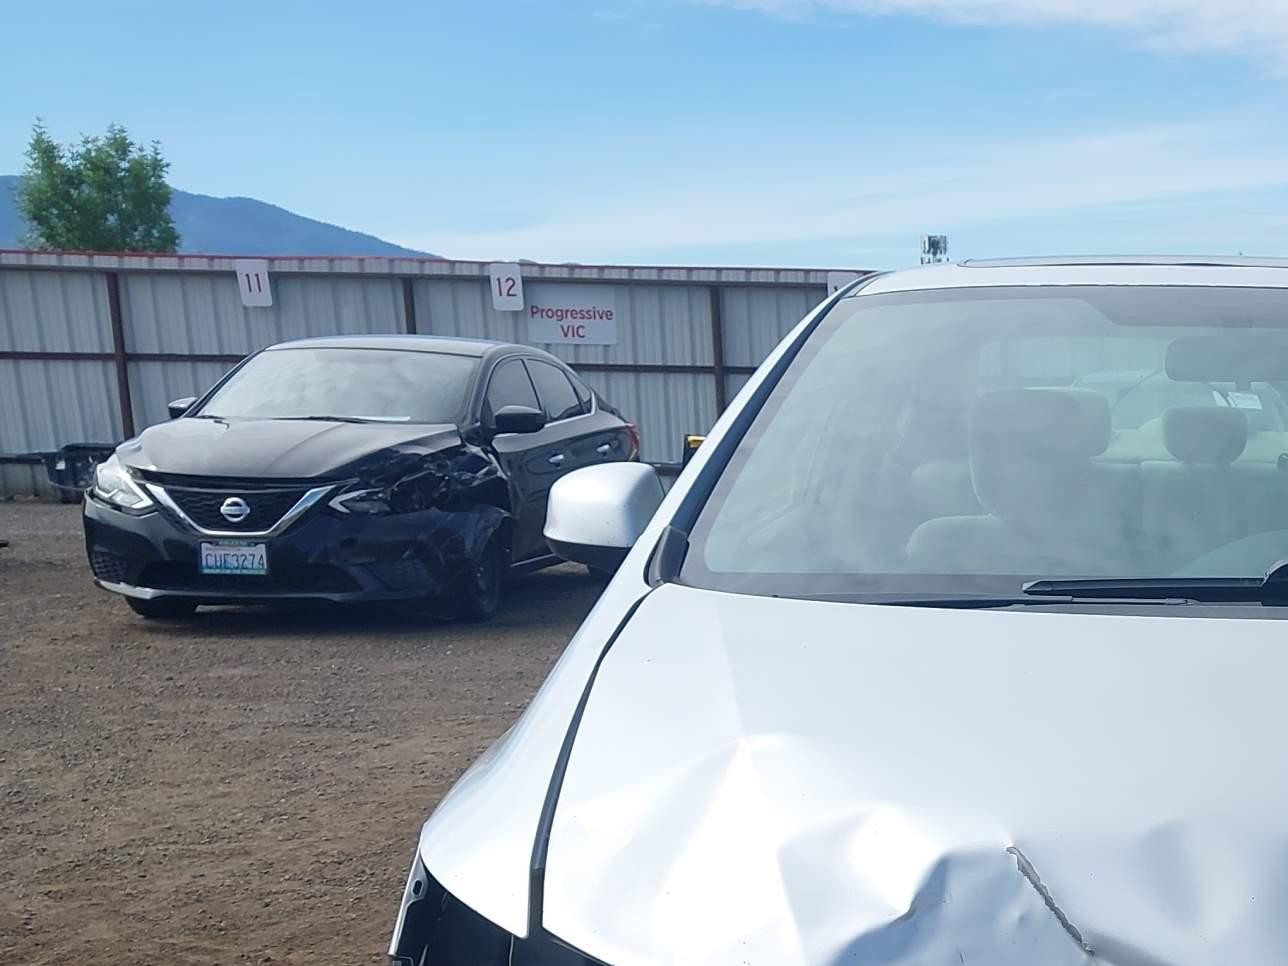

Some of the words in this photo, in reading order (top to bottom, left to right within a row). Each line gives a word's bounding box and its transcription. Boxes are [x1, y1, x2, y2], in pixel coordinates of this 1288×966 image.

[244, 273, 264, 294] 11
[496, 277, 518, 298] 12
[529, 305, 614, 322] Progressive
[559, 325, 586, 339] VIC
